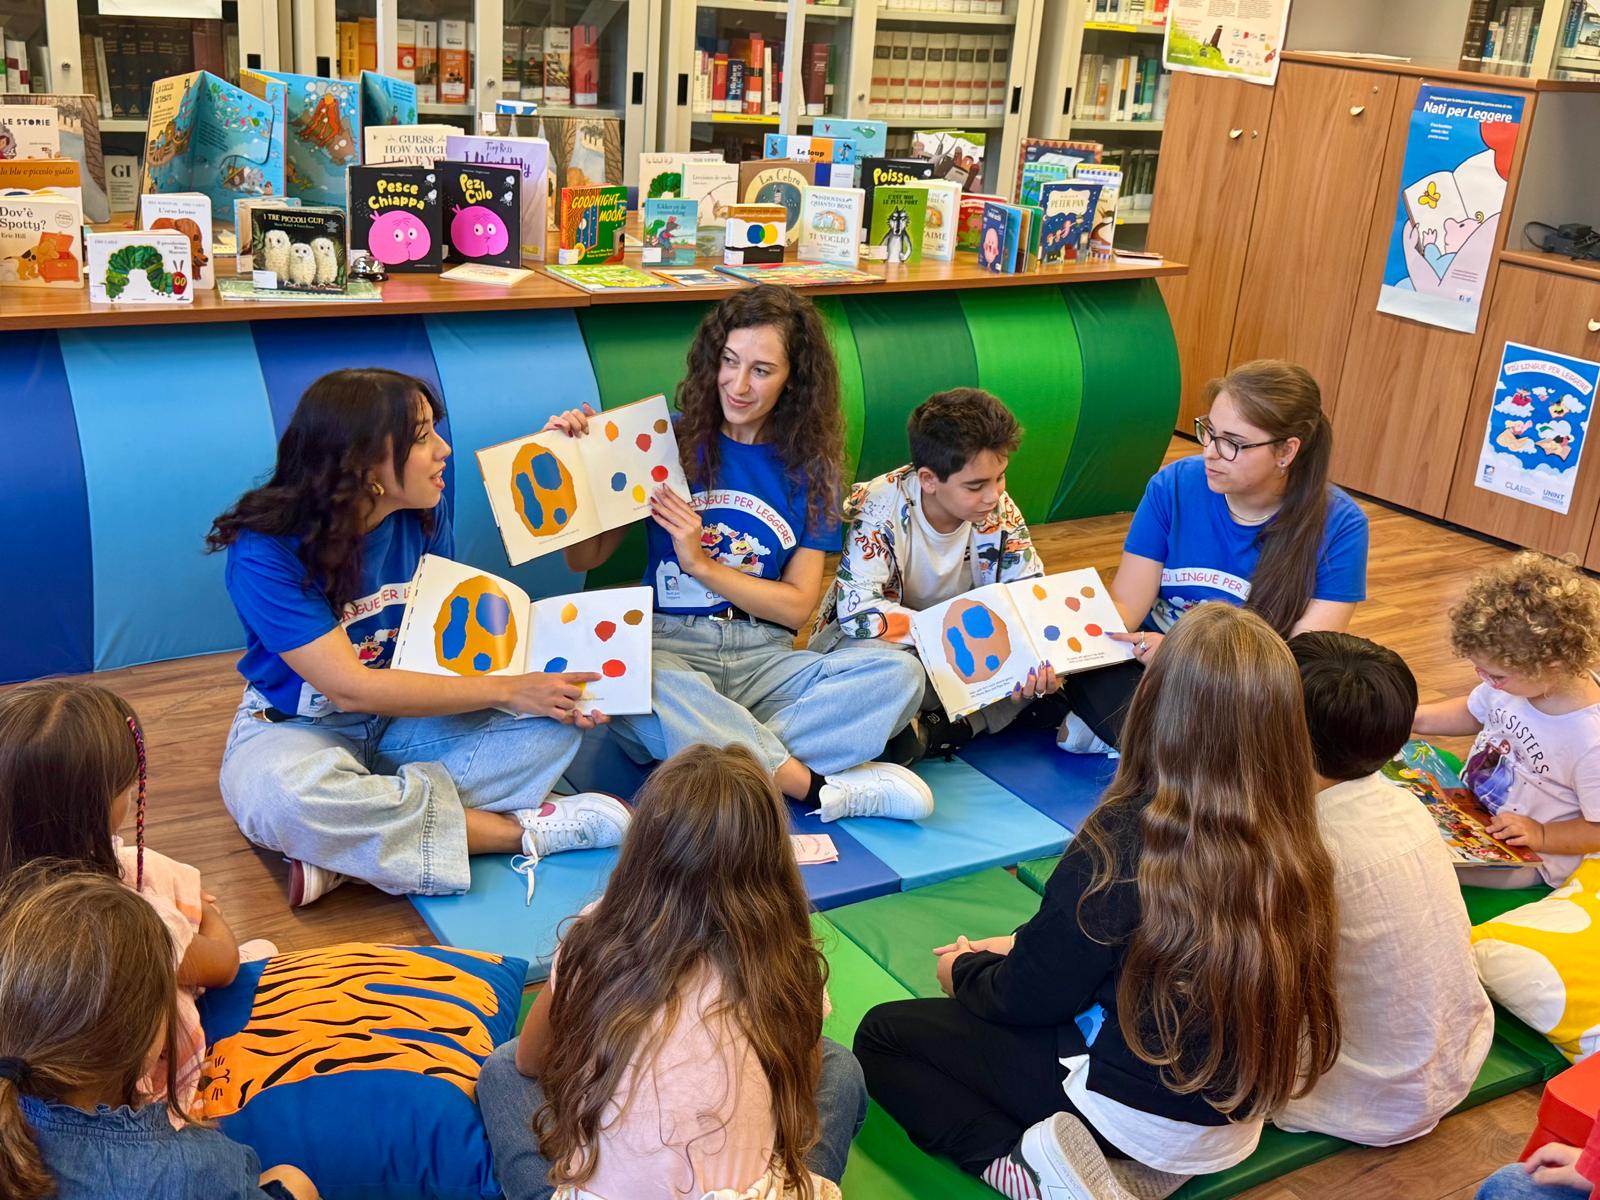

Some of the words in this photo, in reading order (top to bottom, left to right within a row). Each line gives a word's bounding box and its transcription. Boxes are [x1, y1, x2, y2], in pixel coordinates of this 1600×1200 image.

[1423, 101, 1447, 115] Nati
[1446, 106, 1467, 119] per
[1467, 106, 1513, 124] Leggere
[17, 118, 50, 126] STORIE
[399, 135, 434, 144] GUESS
[385, 145, 411, 154] HOW
[807, 149, 825, 158] loup
[29, 168, 54, 177] piccolo
[54, 167, 74, 177] giallo
[758, 173, 774, 185] La
[776, 168, 802, 186] Cebra
[377, 179, 419, 195] Pesce
[459, 173, 481, 193] Pez
[465, 181, 493, 205] Culo
[817, 194, 846, 203] INDOVINA
[368, 194, 426, 211] Chiappa
[571, 192, 621, 209] GOODNIGHT
[810, 200, 836, 208] QUANTO
[836, 202, 853, 210] BENE
[1050, 199, 1071, 208] PETER
[1072, 199, 1084, 208] PAN
[0, 206, 34, 218] Dov'è
[267, 213, 280, 221] TRE
[281, 215, 307, 223] PICCOLI
[307, 216, 325, 225] GUFI
[599, 207, 625, 223] MOON
[0, 217, 47, 231] Spotty?
[809, 232, 817, 240] TI
[820, 234, 850, 244] VOGLIO
[1520, 362, 1548, 371] LINGUE
[1547, 364, 1561, 375] PER
[1561, 370, 1590, 393] LEGGERE
[734, 495, 754, 509] PER
[756, 504, 792, 545] LEGGERE
[1175, 571, 1221, 585] LINGUE
[1222, 577, 1243, 593] PER
[381, 589, 399, 602] ER
[1505, 714, 1549, 774] SISTERS
